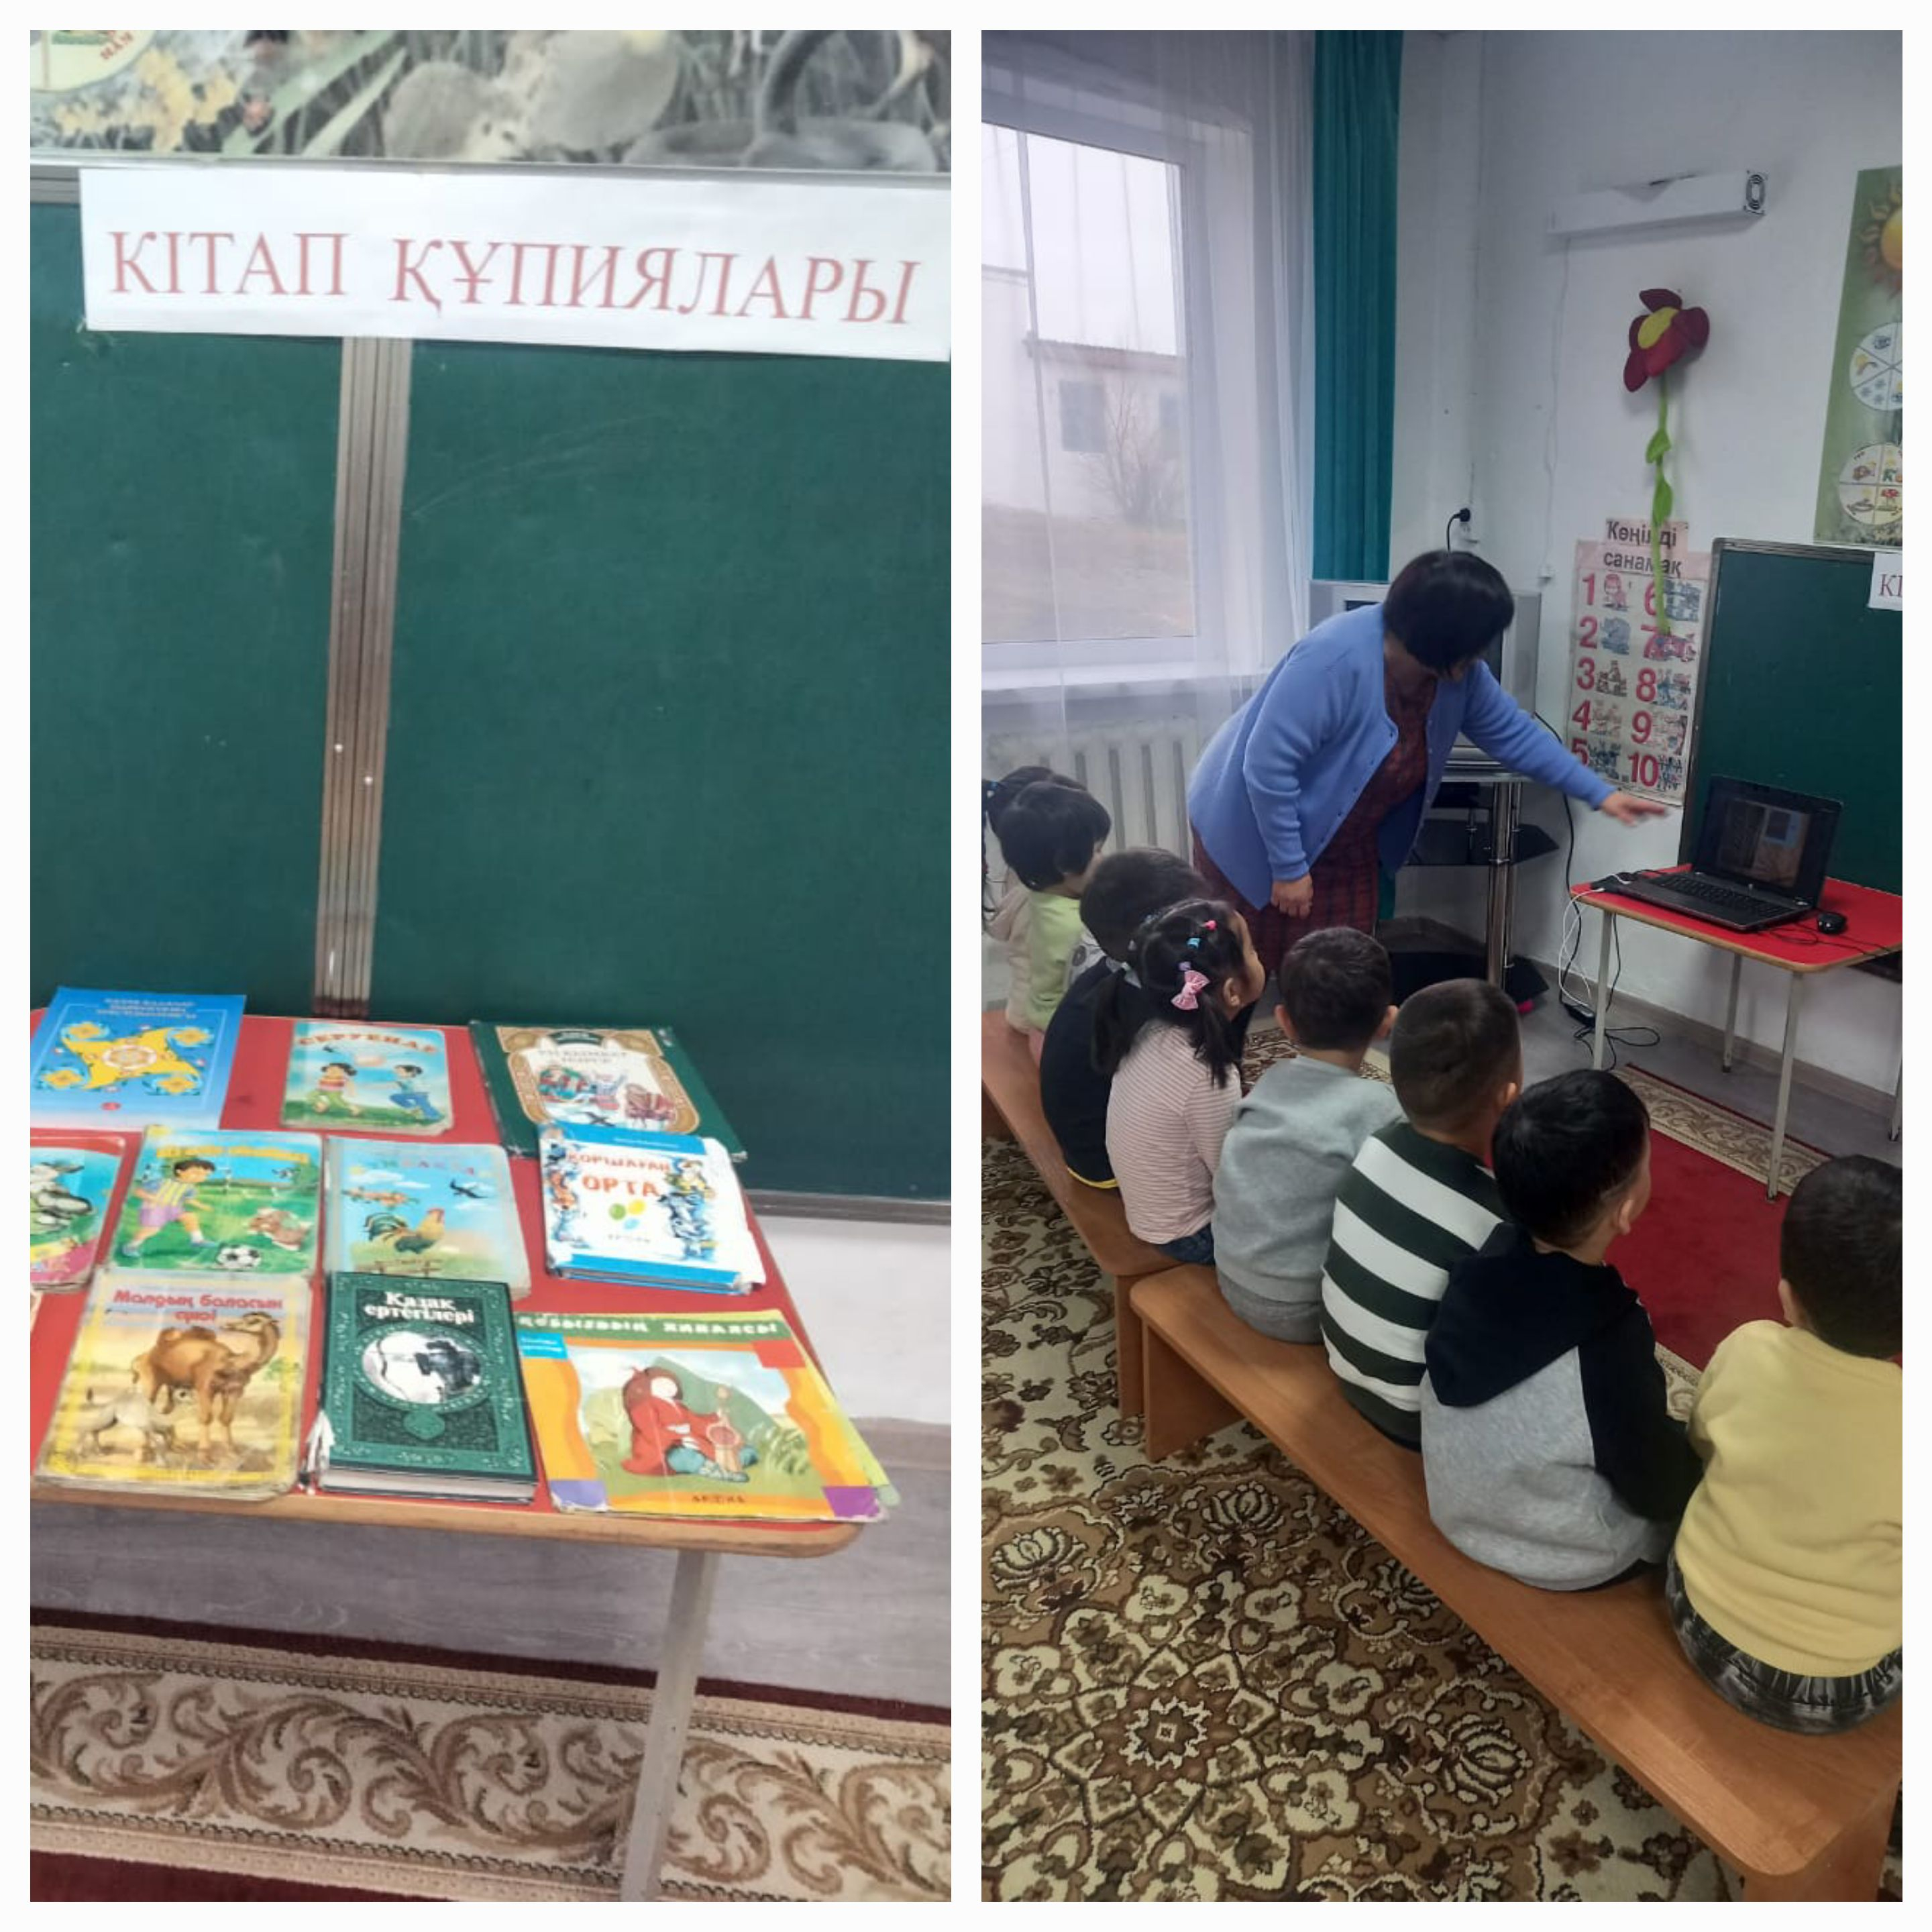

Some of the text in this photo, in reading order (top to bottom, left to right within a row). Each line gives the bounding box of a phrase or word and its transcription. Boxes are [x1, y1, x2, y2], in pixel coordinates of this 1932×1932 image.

[108, 231, 922, 325] КІТАП ҚҰПИЯЛАРЫ
[1582, 574, 1595, 605] 1
[1578, 615, 1598, 649] 2
[1576, 657, 1595, 691] 3
[1635, 667, 1657, 702] 8
[1572, 700, 1591, 731] 4
[1631, 710, 1652, 745] 9
[1627, 751, 1660, 787] 10
[582, 1174, 659, 1197] ОРТА
[113, 1289, 283, 1309] Малдың баласын
